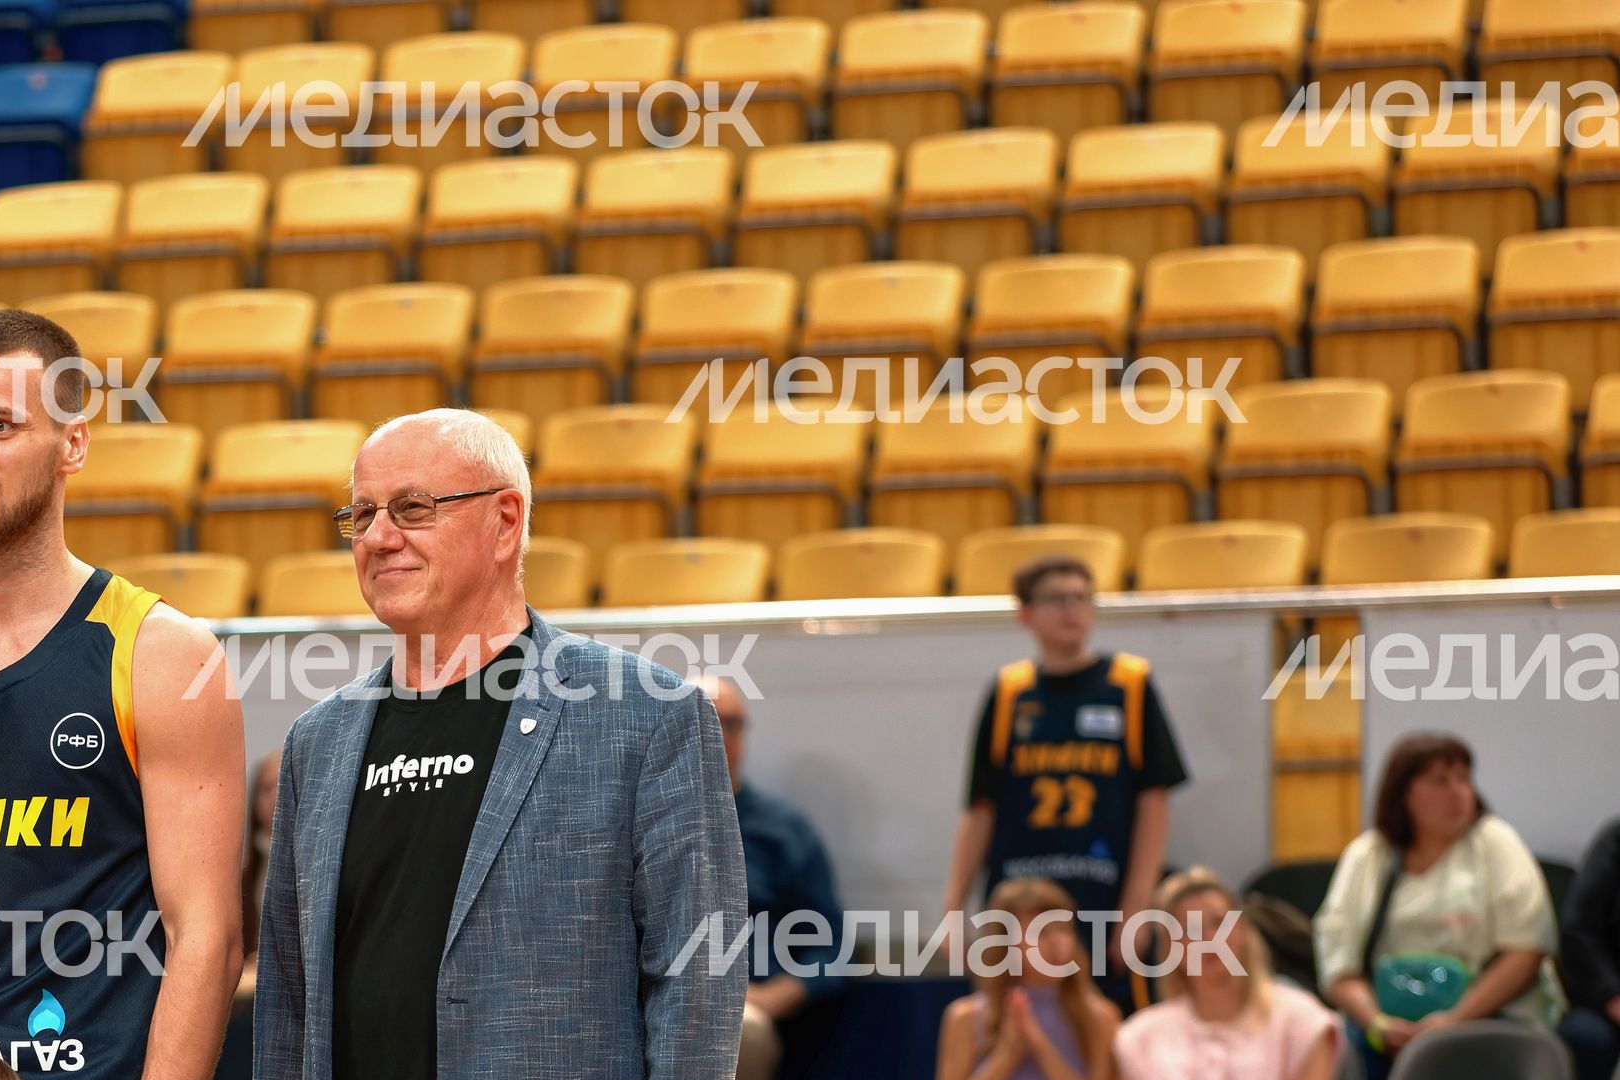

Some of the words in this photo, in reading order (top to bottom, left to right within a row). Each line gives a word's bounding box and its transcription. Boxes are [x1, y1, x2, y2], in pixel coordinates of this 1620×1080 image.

[57, 734, 98, 748] РФБ
[365, 754, 474, 791] Inferno
[383, 779, 444, 797] STYLE
[1029, 775, 1096, 827] 23
